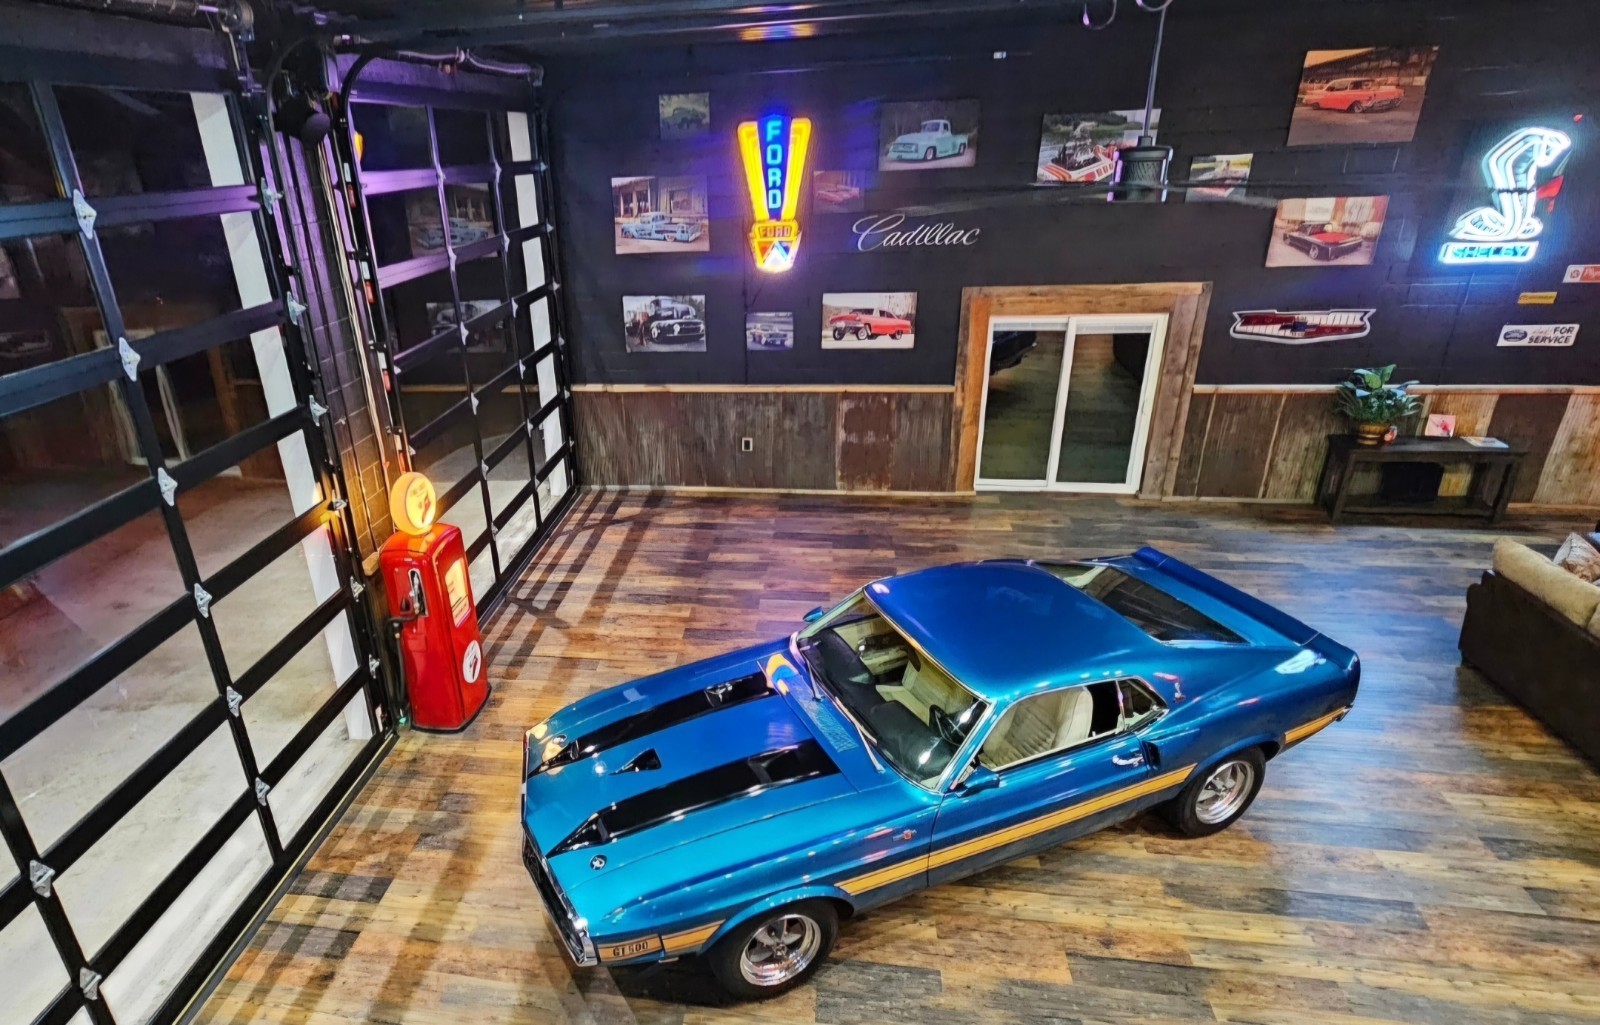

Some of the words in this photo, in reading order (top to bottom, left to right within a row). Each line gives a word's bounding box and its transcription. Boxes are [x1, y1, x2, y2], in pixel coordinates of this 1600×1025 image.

[766, 120, 783, 209] FORD
[852, 213, 980, 252] Cadillac
[1528, 336, 1571, 344] SERVICE
[1553, 326, 1575, 335] FOR
